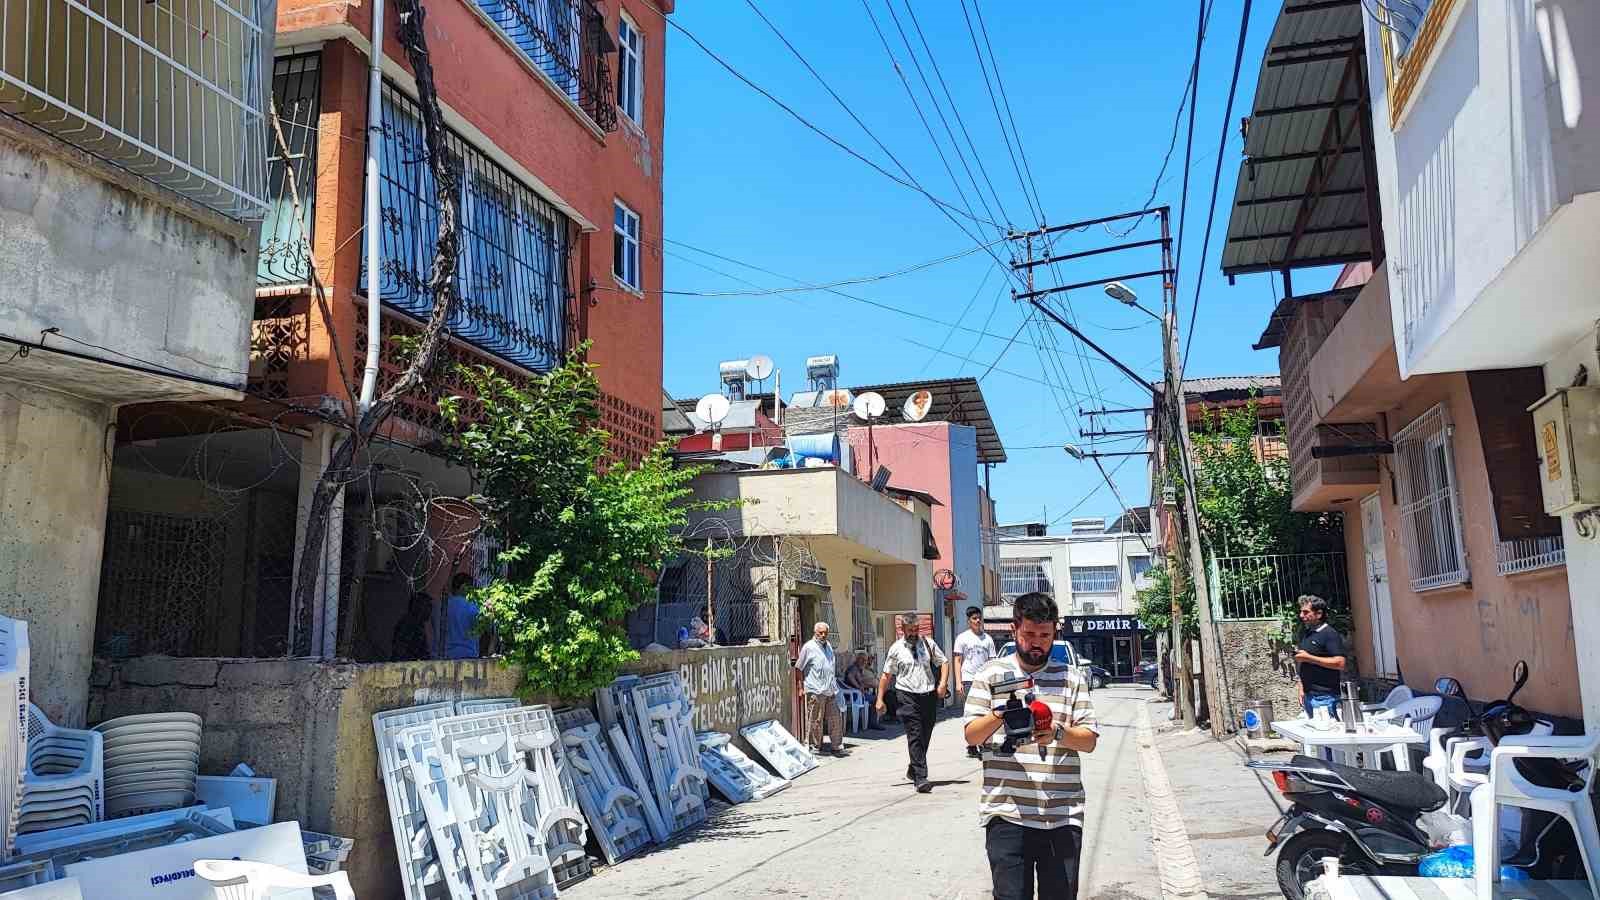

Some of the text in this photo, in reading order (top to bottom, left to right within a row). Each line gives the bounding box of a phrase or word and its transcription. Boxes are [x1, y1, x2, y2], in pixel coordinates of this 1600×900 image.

[1087, 618, 1131, 630] DEMİR
[681, 652, 782, 699] BU BİNA SATILIKTIR
